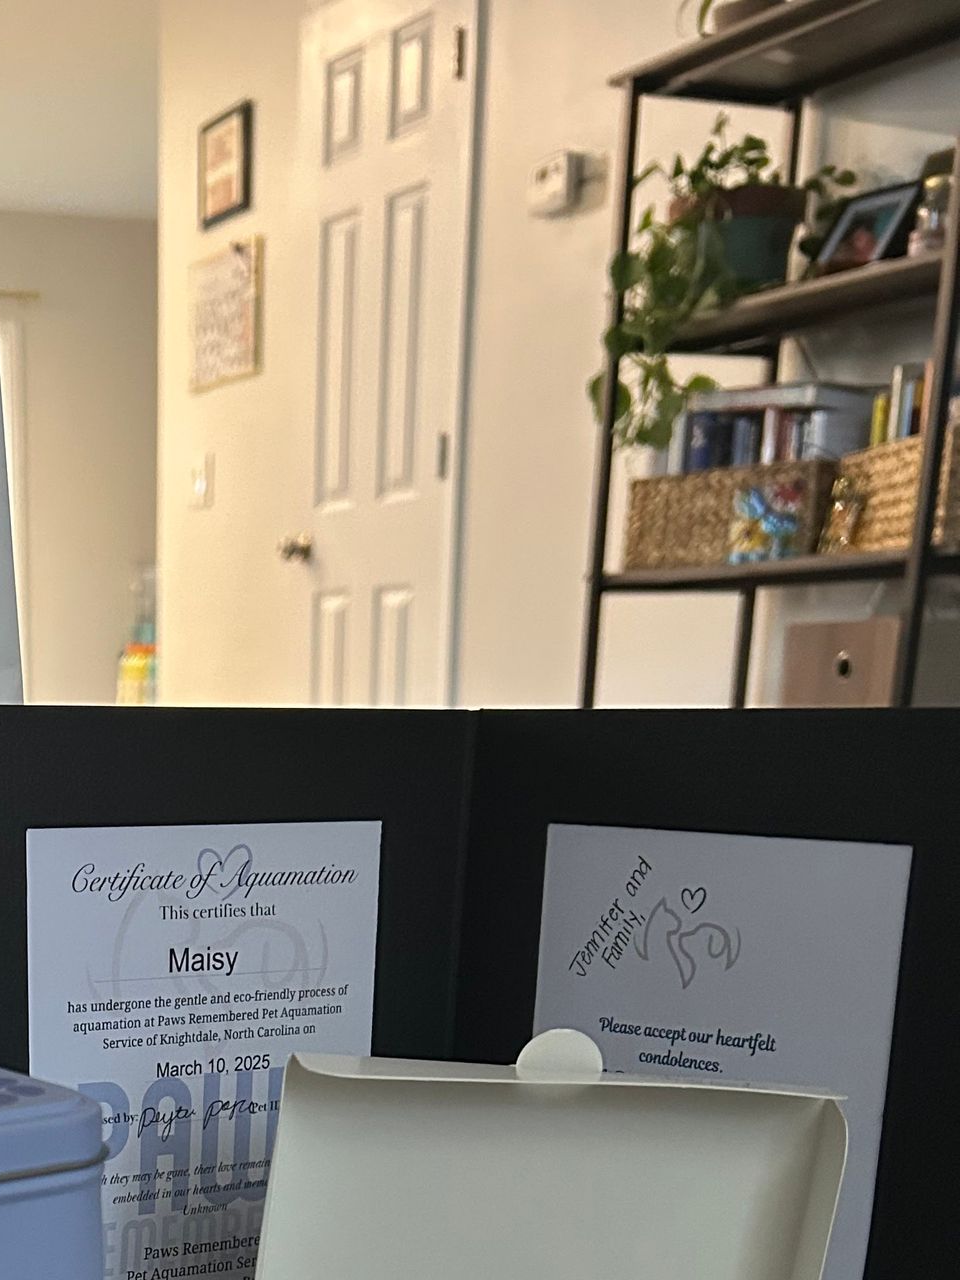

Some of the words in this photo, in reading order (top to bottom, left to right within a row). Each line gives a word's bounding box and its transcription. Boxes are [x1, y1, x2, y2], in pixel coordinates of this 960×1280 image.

[71, 862, 187, 902] Certificate
[186, 860, 222, 900] of
[220, 859, 359, 899] Aquamation
[159, 905, 190, 920] This
[192, 903, 246, 919] certifies
[250, 903, 276, 917] that
[568, 898, 624, 977] Jennifer
[625, 855, 652, 897] and
[169, 946, 239, 976] Maisy
[67, 1001, 88, 1013] has
[90, 999, 152, 1013] undergone
[154, 996, 172, 1008] the
[174, 994, 208, 1009] gentle
[210, 992, 231, 1005] and
[233, 988, 296, 1003] eco-friendly
[298, 986, 336, 1002] process
[338, 984, 350, 996] of
[73, 1018, 142, 1035] aquamation
[144, 1017, 155, 1028] at
[157, 1015, 186, 1027] Paws
[188, 1008, 259, 1025] Remembered
[262, 1008, 278, 1019] Pet
[280, 1004, 342, 1020] Aquamation
[103, 1036, 143, 1049] Service
[146, 1034, 158, 1046] of
[160, 1029, 221, 1047] Knightdale,
[224, 1027, 254, 1040] North
[257, 1024, 300, 1038] Carolina
[303, 1024, 316, 1034] on
[599, 1016, 642, 1036] Please
[644, 1025, 687, 1046] accept
[688, 1031, 713, 1044] our
[715, 1028, 777, 1057] heartfelt
[156, 1060, 203, 1078] March
[208, 1058, 229, 1075] 10,
[234, 1054, 270, 1072] 2025
[639, 1050, 723, 1073] condolences.
[110, 1172, 130, 1187] they
[132, 1172, 152, 1184] may
[153, 1168, 165, 1179] be
[193, 1164, 216, 1176] their
[217, 1161, 236, 1173] love
[112, 1187, 160, 1205] embedded
[161, 1187, 172, 1199] in
[174, 1187, 190, 1198] our
[192, 1182, 220, 1195] hearts
[222, 1179, 242, 1191] and
[143, 1246, 179, 1260] Paws
[182, 1234, 260, 1256] Remembere
